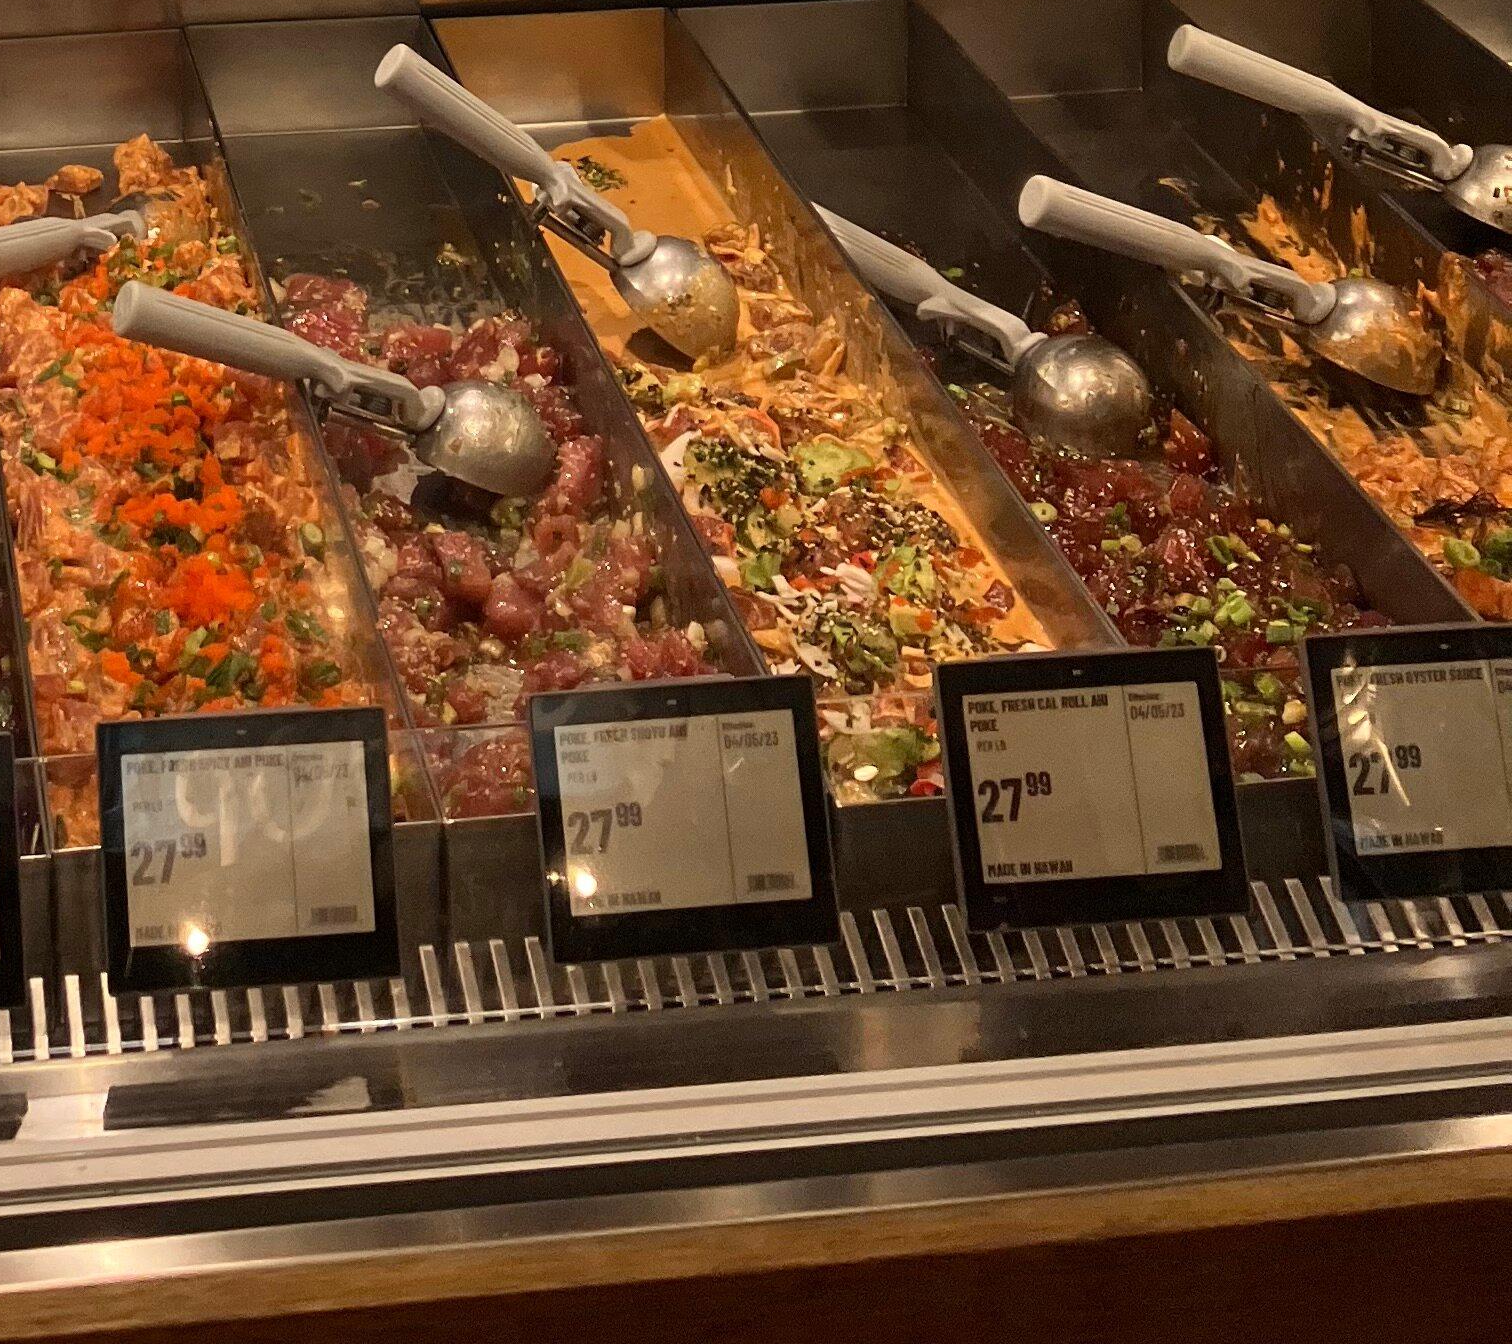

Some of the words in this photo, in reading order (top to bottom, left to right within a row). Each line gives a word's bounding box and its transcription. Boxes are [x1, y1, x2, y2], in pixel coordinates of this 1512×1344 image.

[1370, 672, 1404, 686] FRESH
[1405, 669, 1447, 684] OYSTER
[1449, 667, 1484, 681] SAUCE
[1001, 698, 1036, 713] FRESH
[1037, 697, 1059, 711] CAL
[1061, 695, 1089, 709] ROLL
[631, 726, 666, 741] SHOYU
[969, 719, 1000, 733] POKE
[987, 863, 1018, 878] MADE
[1019, 862, 1031, 876] IN
